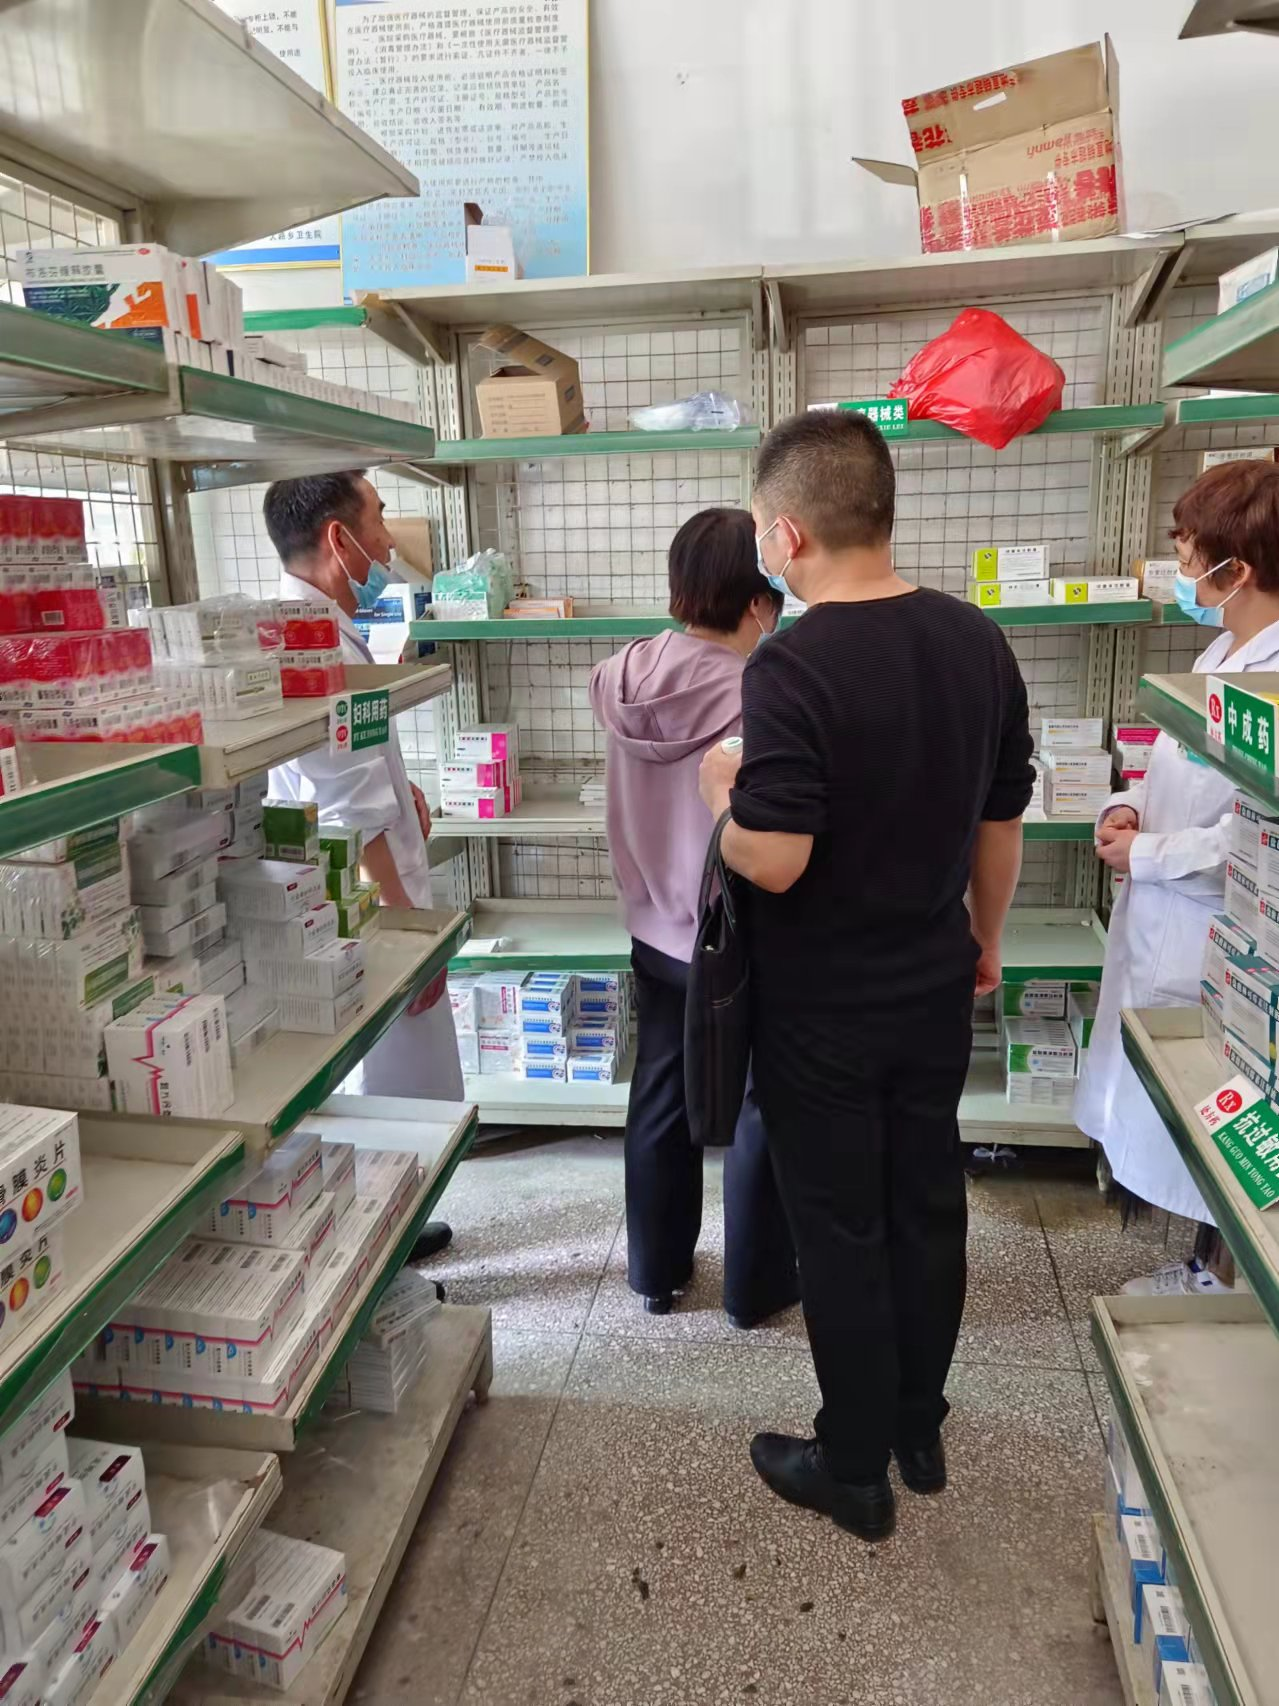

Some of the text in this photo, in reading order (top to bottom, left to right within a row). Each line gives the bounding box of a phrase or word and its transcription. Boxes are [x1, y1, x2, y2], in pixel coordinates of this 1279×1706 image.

[353, 698, 388, 725] 妇科用药
[1211, 698, 1220, 719] Rx
[1228, 701, 1269, 754] 中成药
[1219, 1091, 1237, 1112] Rx
[1232, 1110, 1279, 1178] 抗过敏用
[1217, 1132, 1276, 1198] KANG GUO MIN YONG YAO
